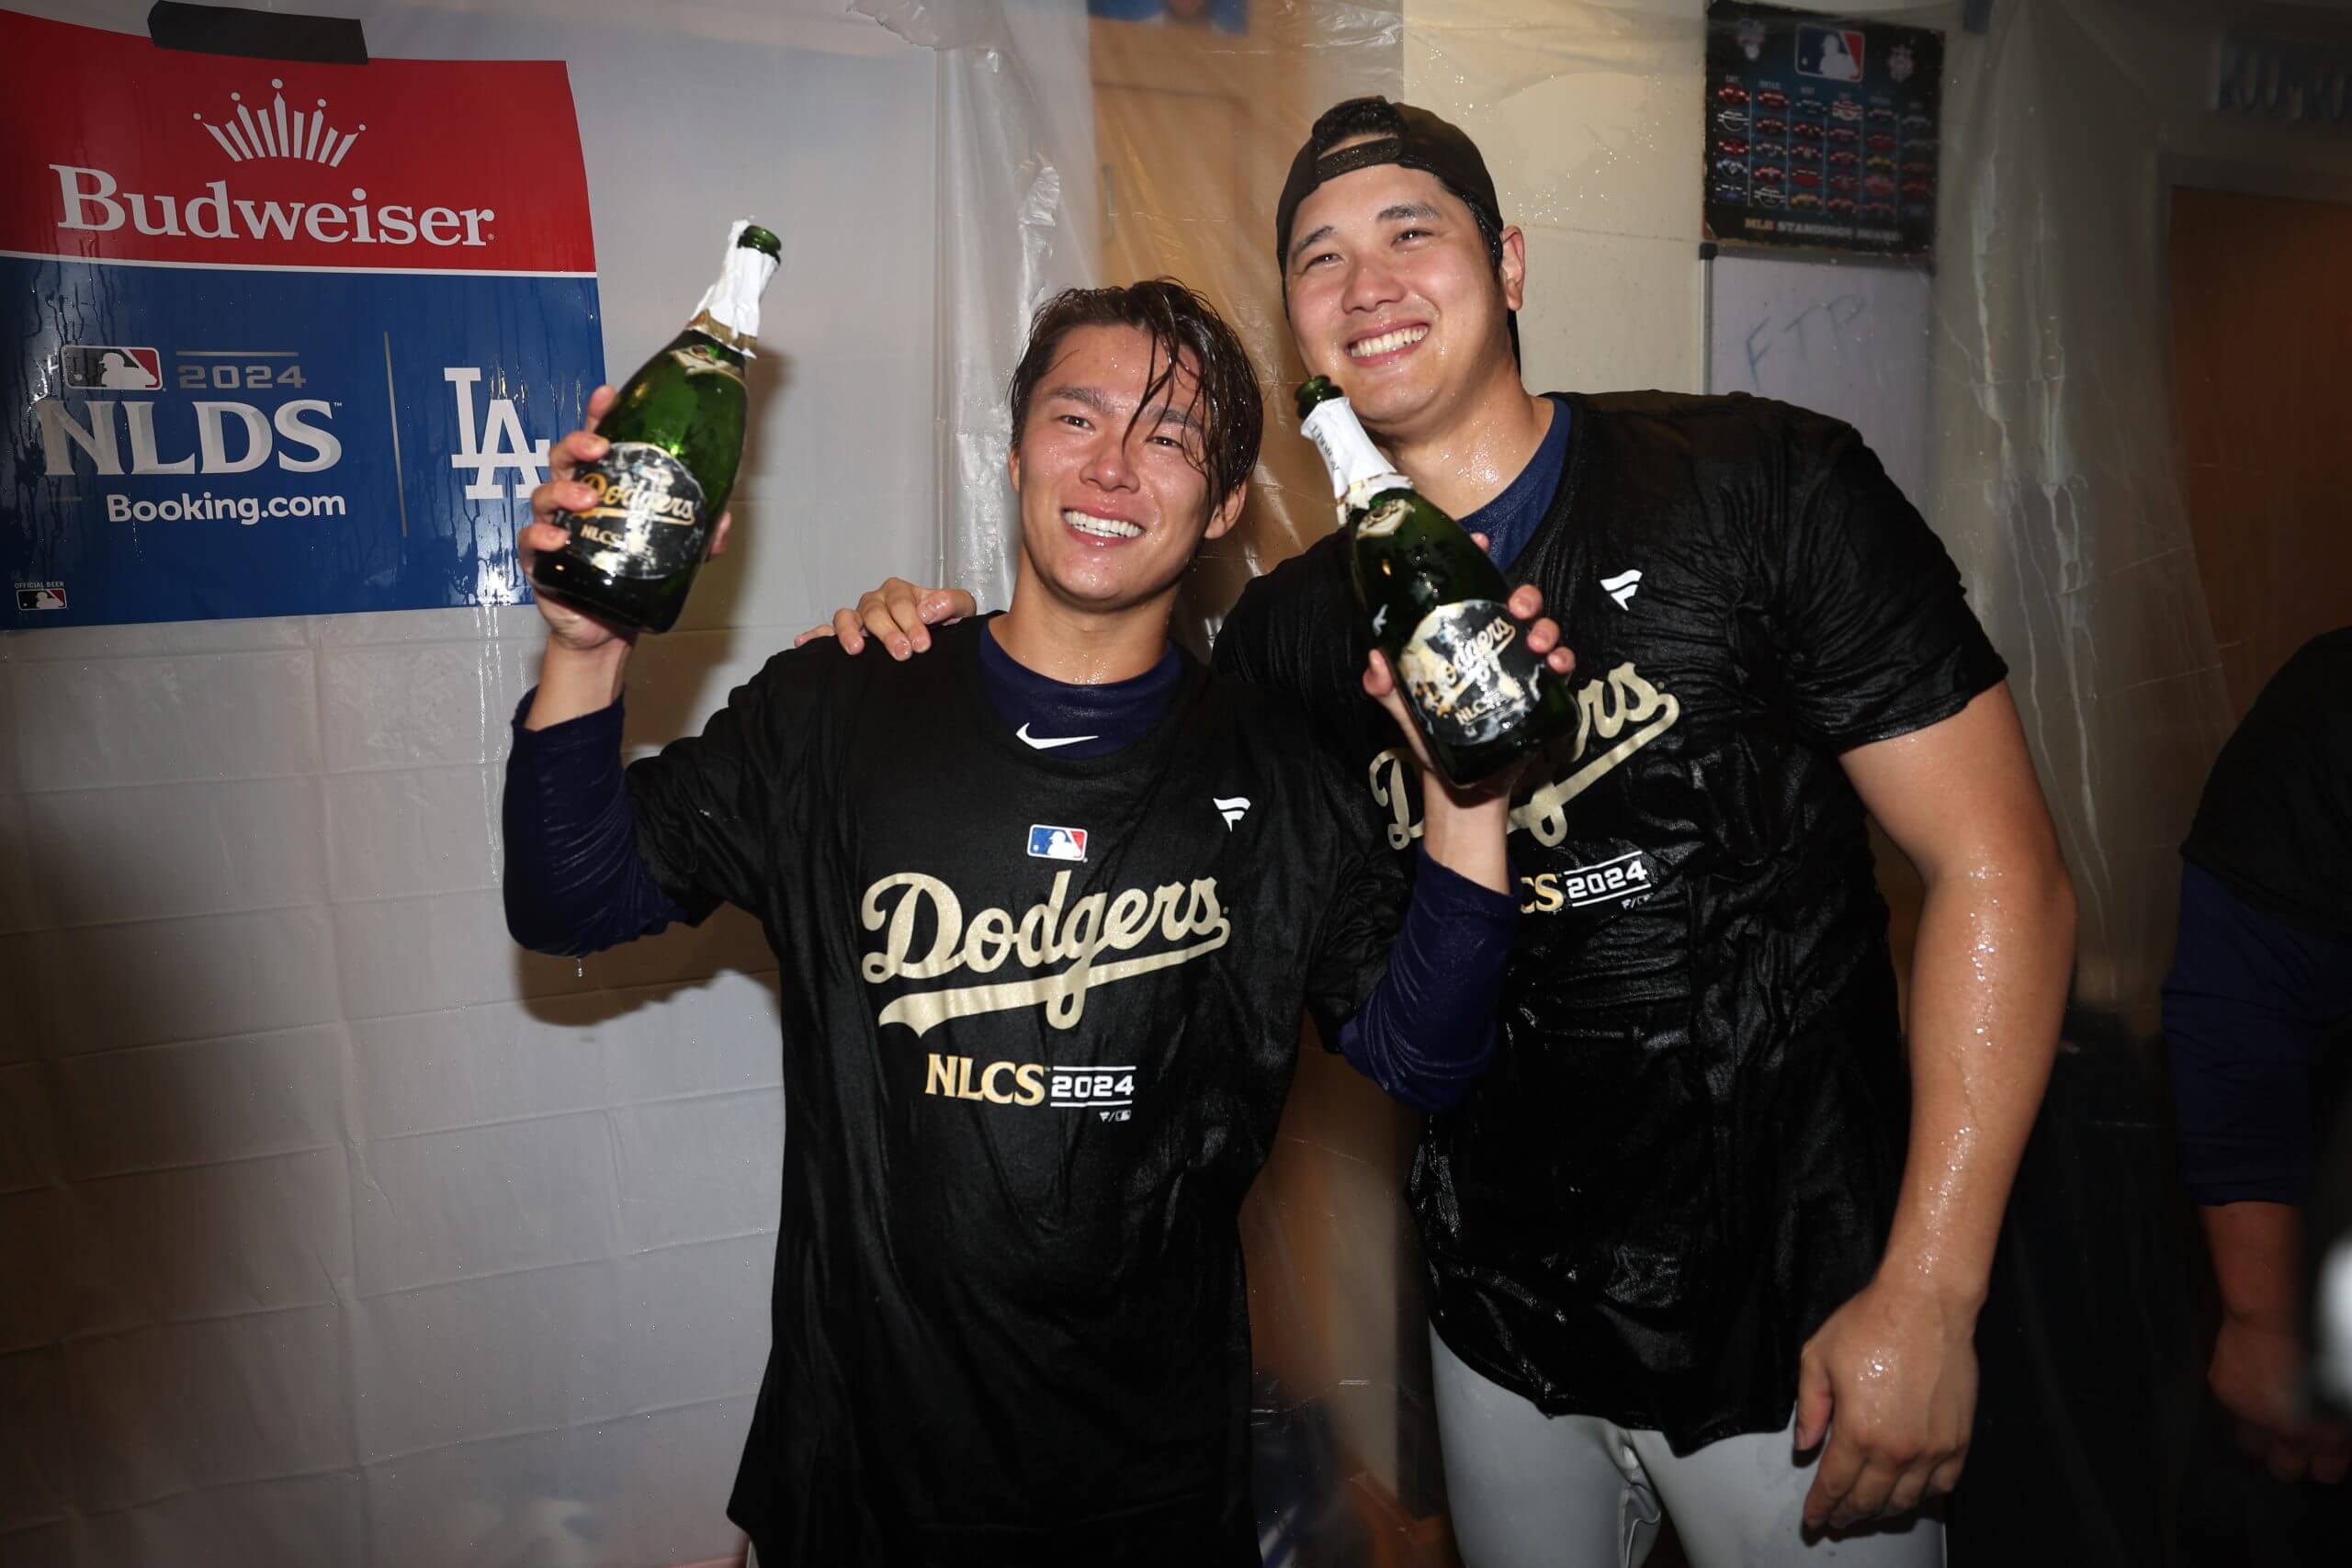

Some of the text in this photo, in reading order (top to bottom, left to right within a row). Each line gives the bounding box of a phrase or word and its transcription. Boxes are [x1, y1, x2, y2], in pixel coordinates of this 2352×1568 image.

[49, 163, 495, 247] Budweiser
[178, 365, 306, 389] 2024
[38, 399, 344, 476] NLDS
[107, 491, 346, 525] Booking.com
[1566, 860, 1648, 899] 2024
[861, 869, 1231, 1038] Dodgers
[924, 1053, 1135, 1106] NLCS 2024
